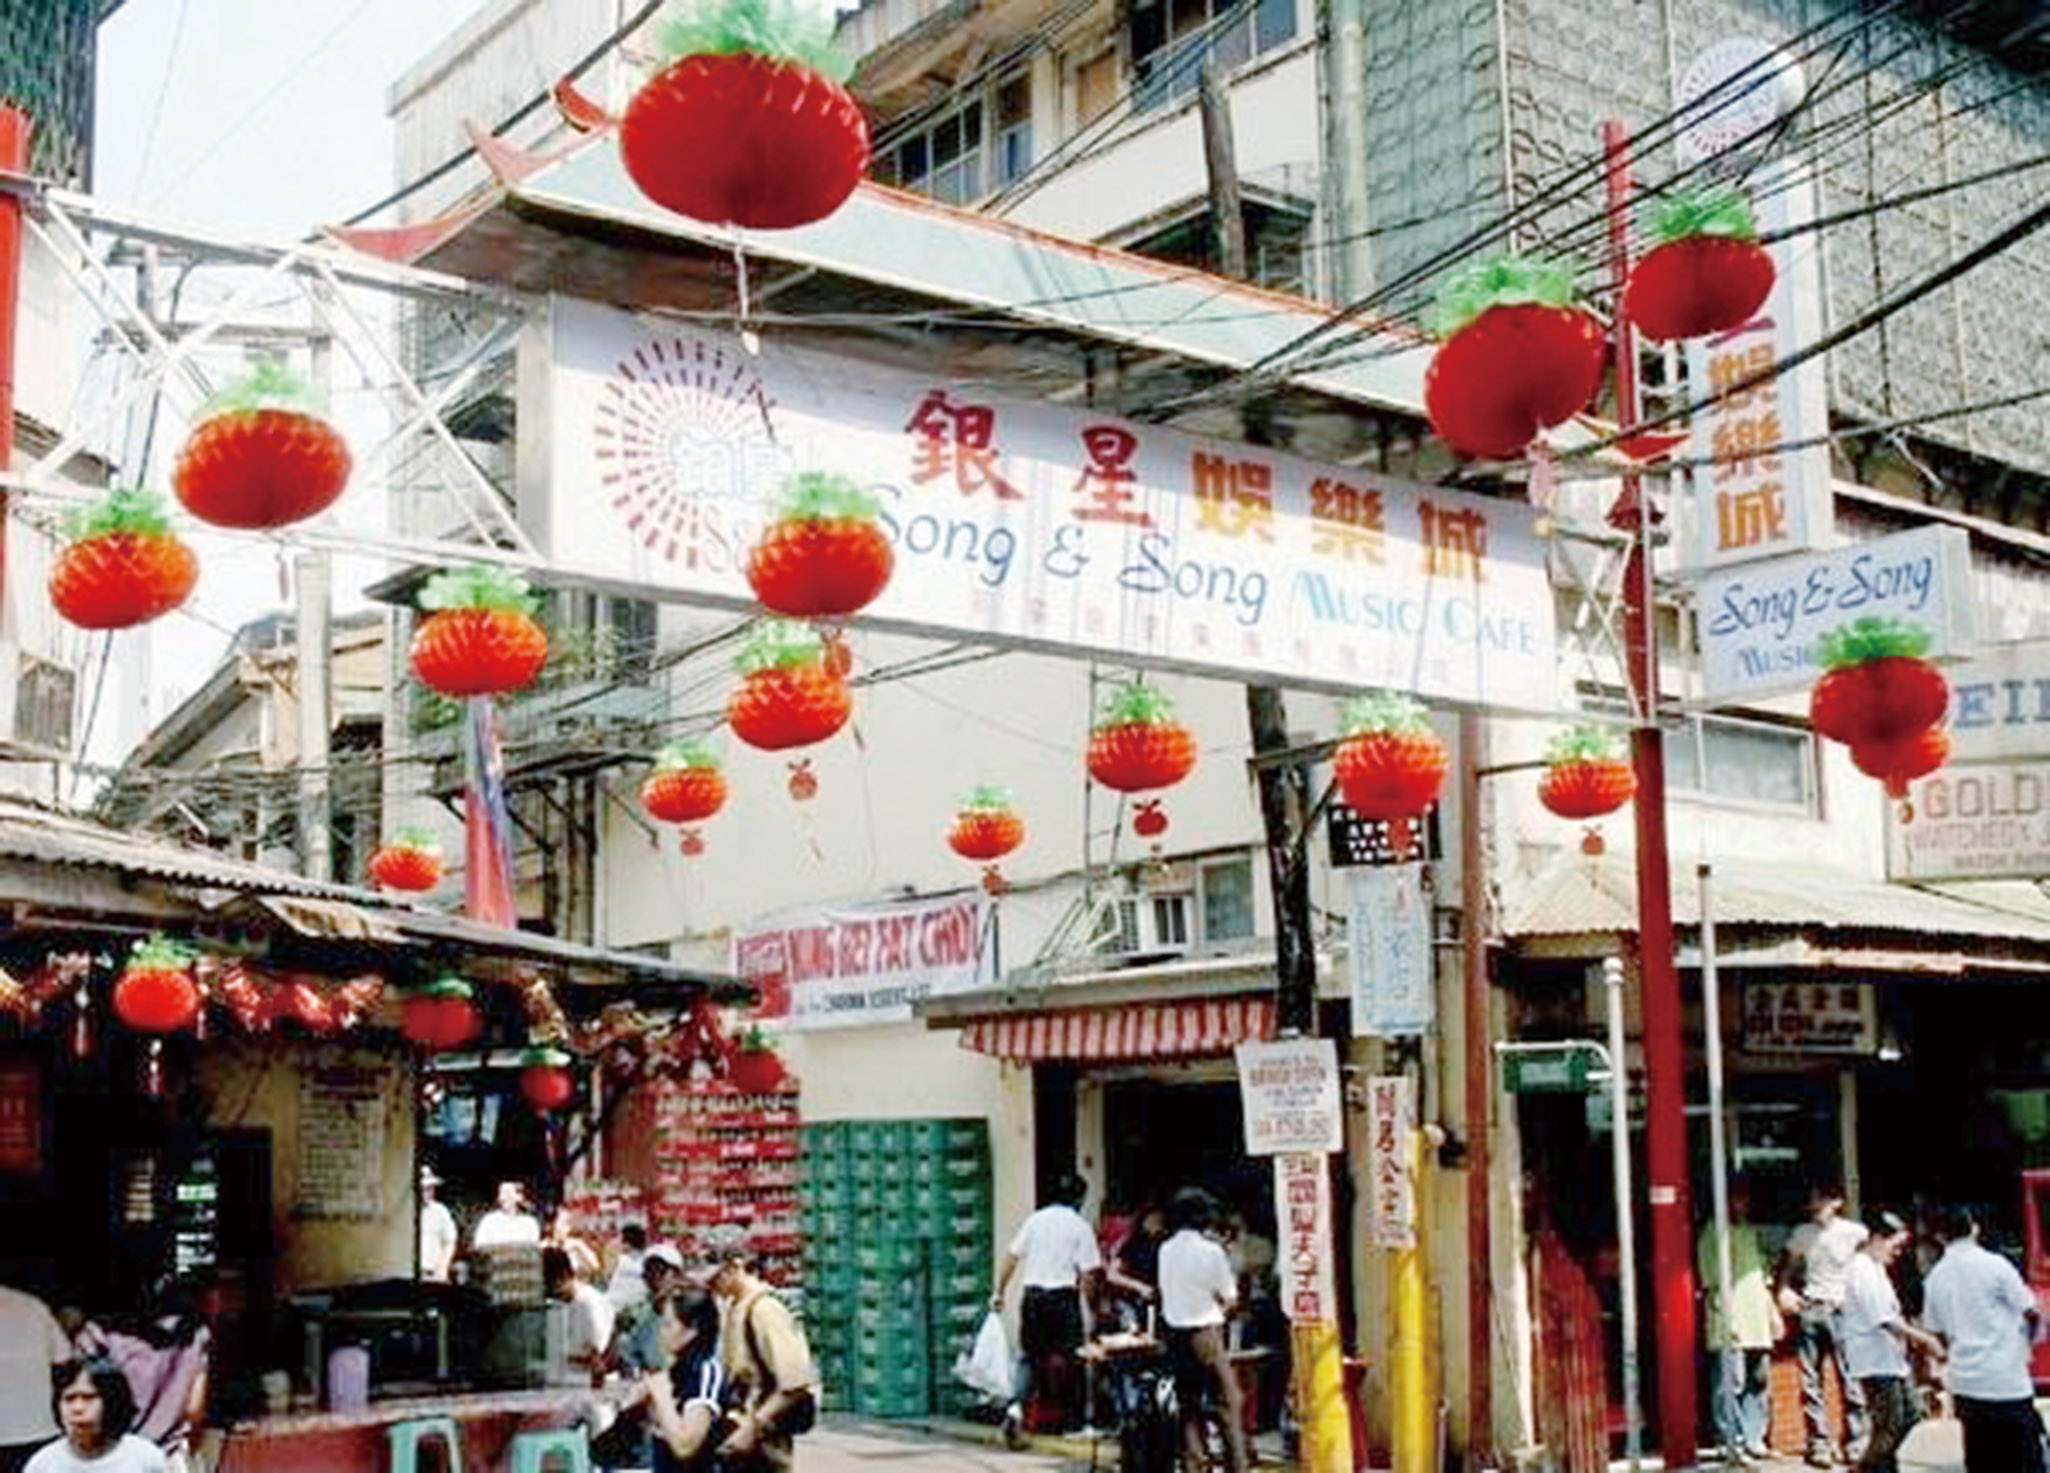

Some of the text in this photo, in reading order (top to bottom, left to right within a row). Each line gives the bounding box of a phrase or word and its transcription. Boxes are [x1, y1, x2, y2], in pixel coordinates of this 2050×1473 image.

[1043, 525, 1090, 579] &
[1117, 533, 1268, 627] Song
[1709, 584, 1798, 640] Song
[1836, 555, 1932, 610] Song
[1924, 773, 2050, 820] GOLD
